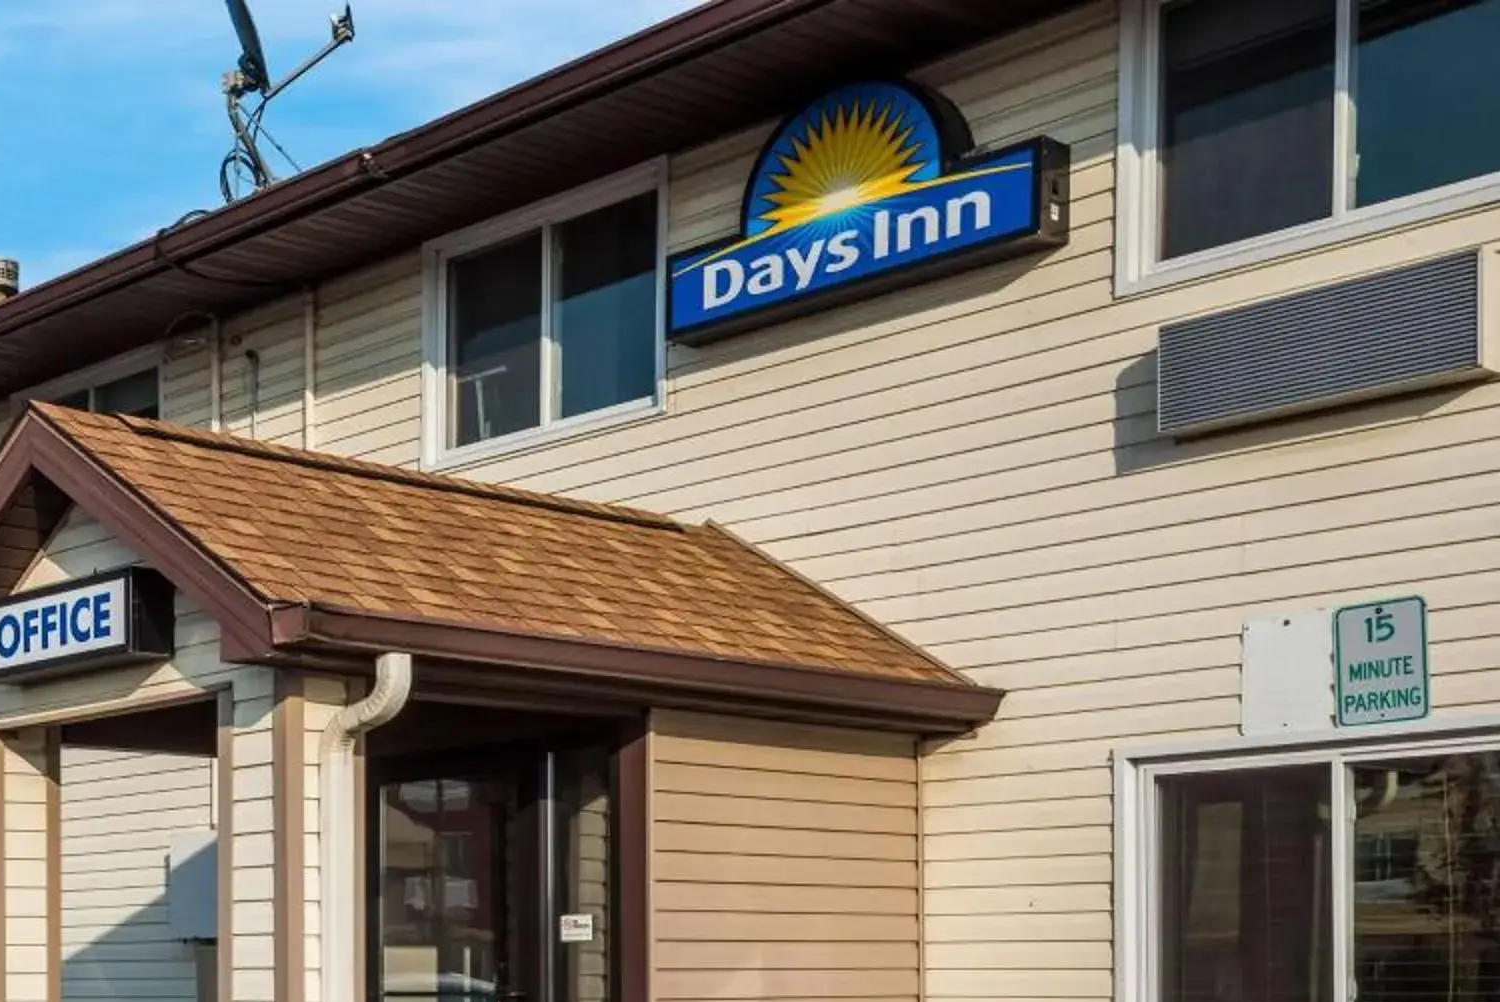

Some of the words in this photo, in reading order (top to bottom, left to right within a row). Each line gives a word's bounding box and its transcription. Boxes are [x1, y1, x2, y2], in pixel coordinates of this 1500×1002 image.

[703, 229, 860, 310] Days
[873, 190, 992, 259] Inn
[1364, 614, 1395, 643] 15
[1349, 655, 1414, 682] MINUTE
[1344, 687, 1422, 713] PARKING
